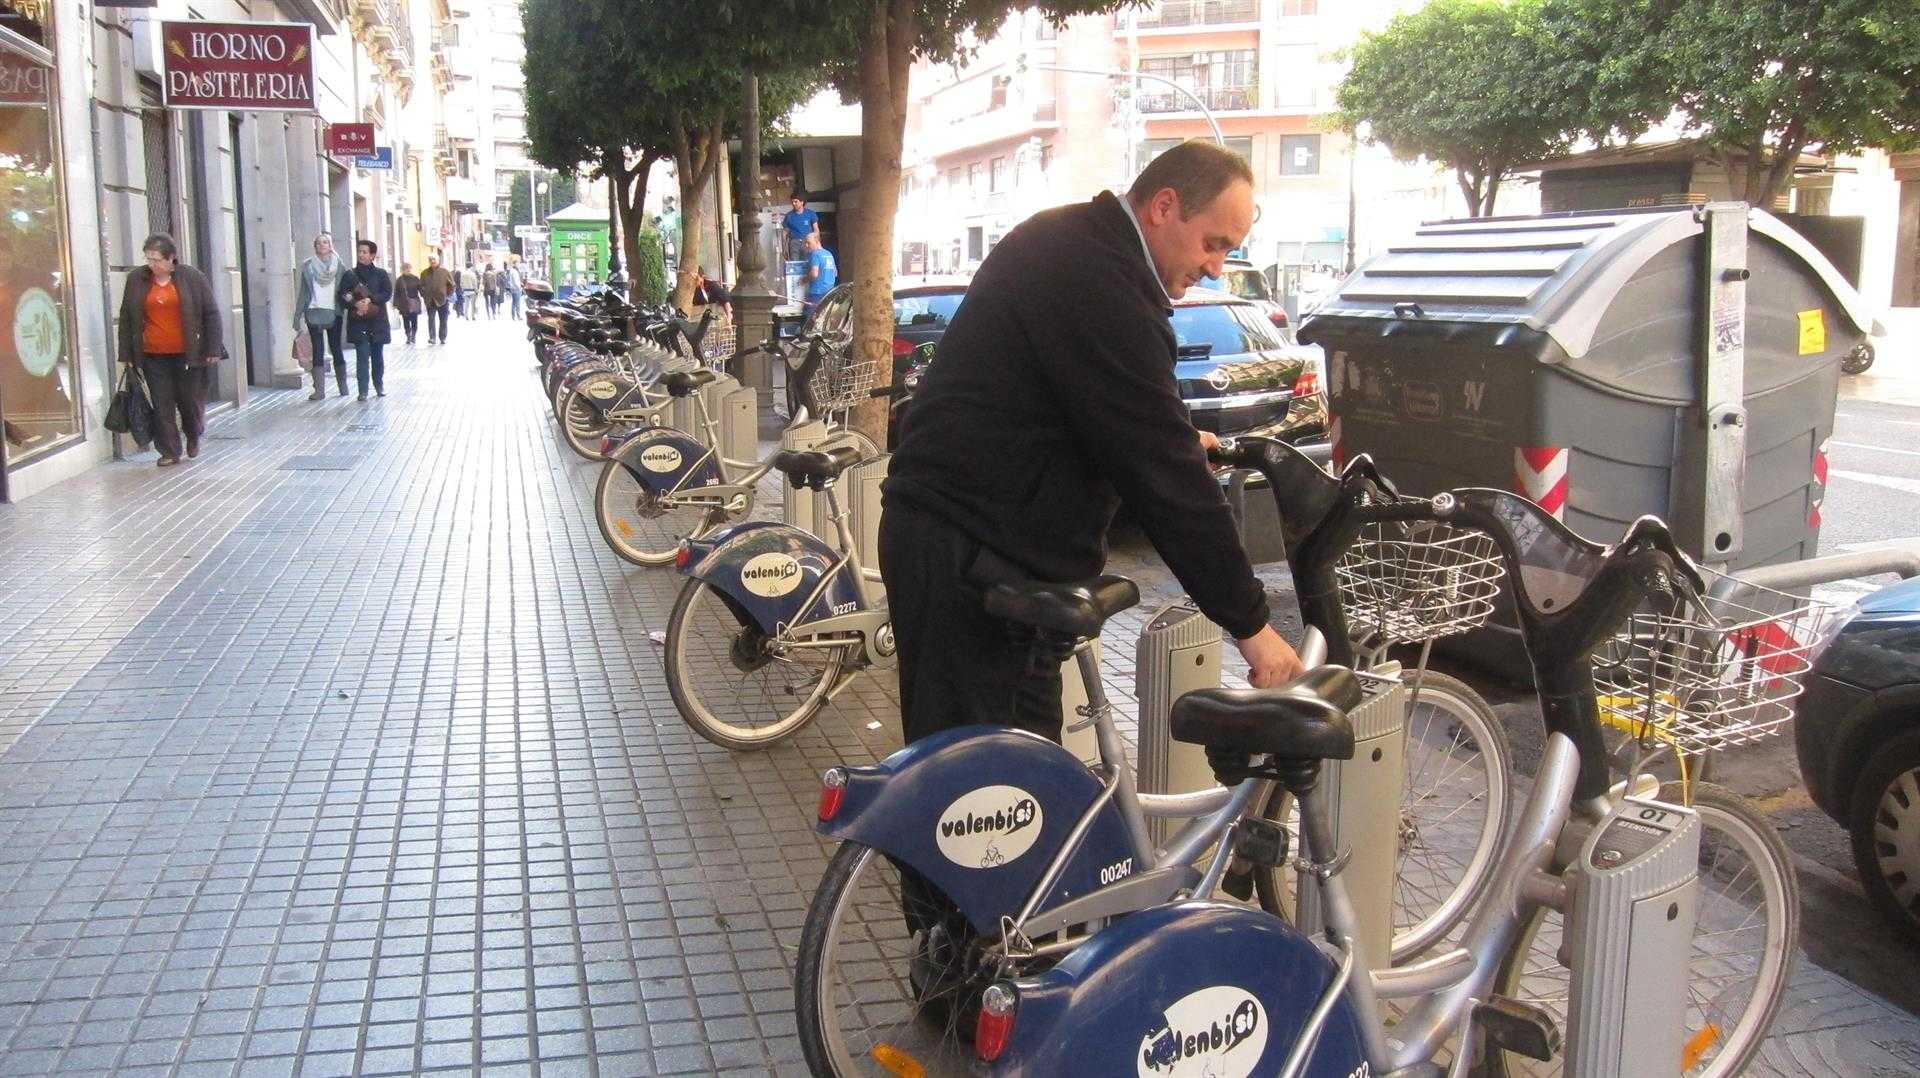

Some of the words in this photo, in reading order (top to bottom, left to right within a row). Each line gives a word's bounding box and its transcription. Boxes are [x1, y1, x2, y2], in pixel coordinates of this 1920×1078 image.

[191, 32, 286, 62] HORNO
[169, 70, 311, 100] PASTELERIA
[567, 230, 593, 241] ONCE
[833, 601, 857, 615] 02272
[941, 799, 1036, 838] valenbisi
[1640, 808, 1667, 823] 01
[1100, 857, 1133, 885] 00247
